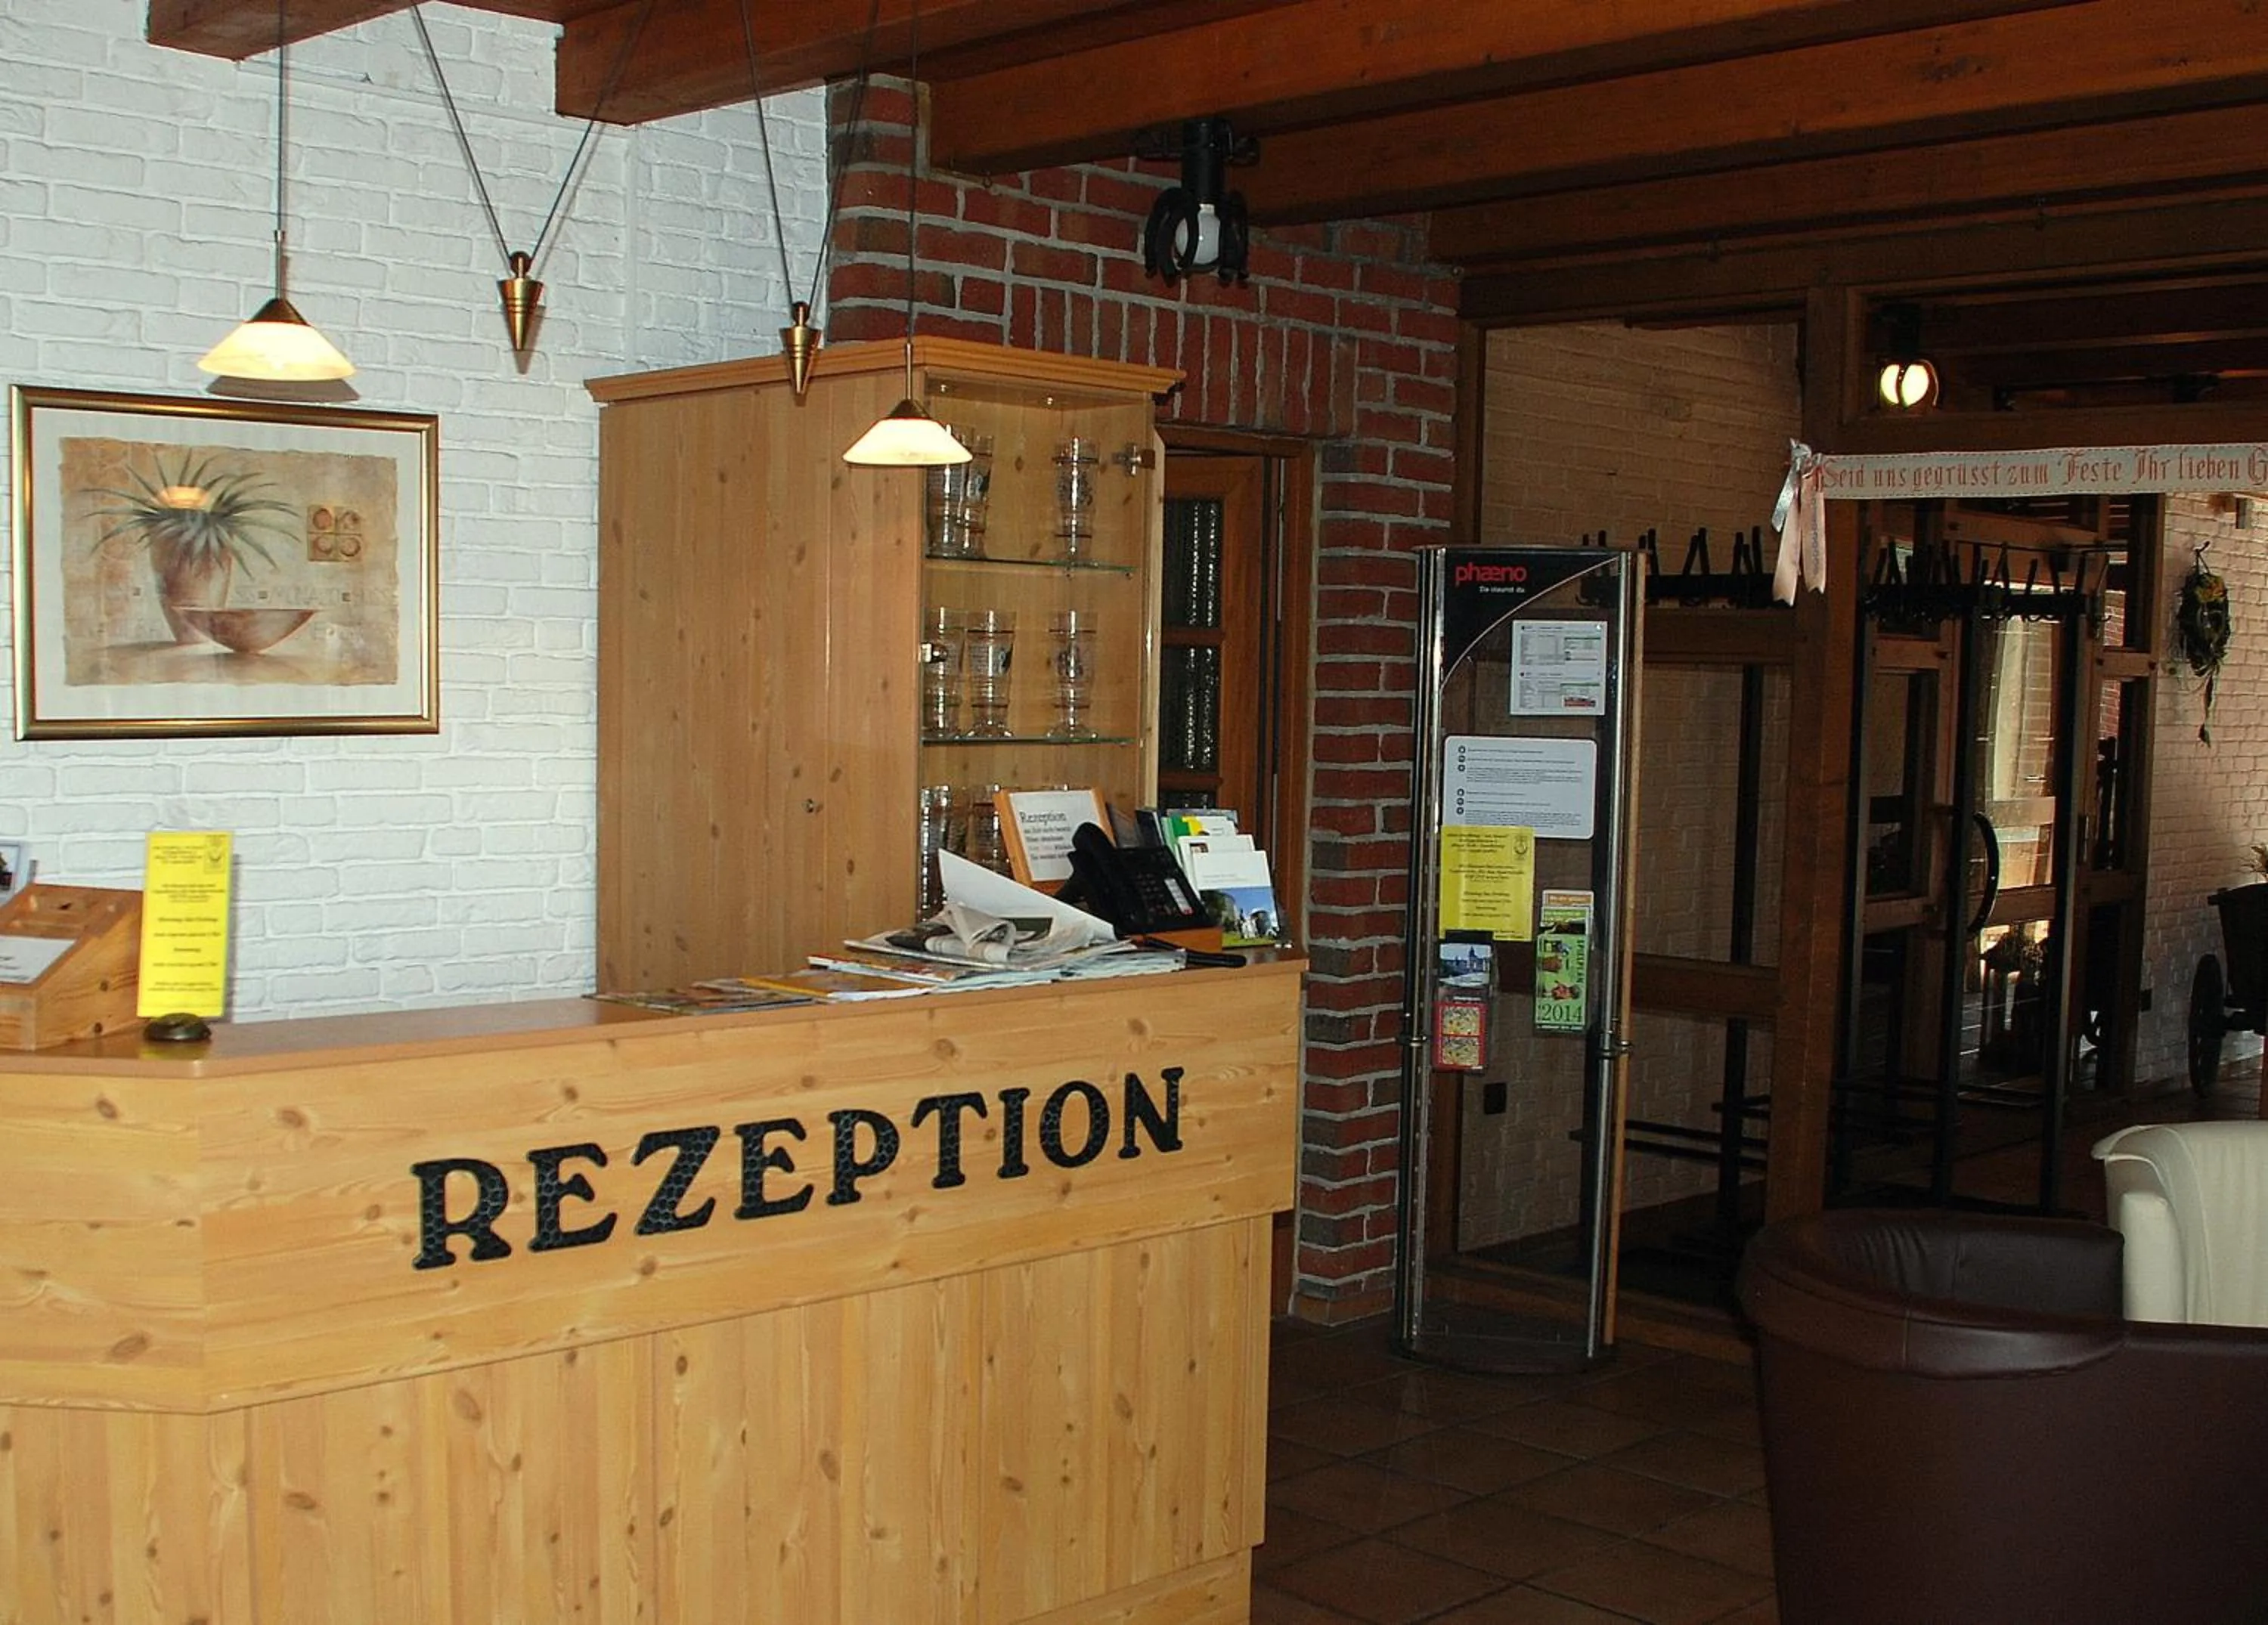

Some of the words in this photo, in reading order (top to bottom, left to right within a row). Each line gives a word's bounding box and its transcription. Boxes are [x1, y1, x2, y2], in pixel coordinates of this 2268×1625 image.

[1822, 458, 1864, 488] Seid
[1873, 466, 1907, 488] uns
[2007, 463, 2050, 486] zum
[2059, 450, 2123, 486] Feste
[2131, 449, 2171, 484] Ihr
[2178, 449, 2239, 481] lieben
[1541, 1003, 1582, 1022] 2014
[411, 1066, 1185, 1271] REZEPTION
